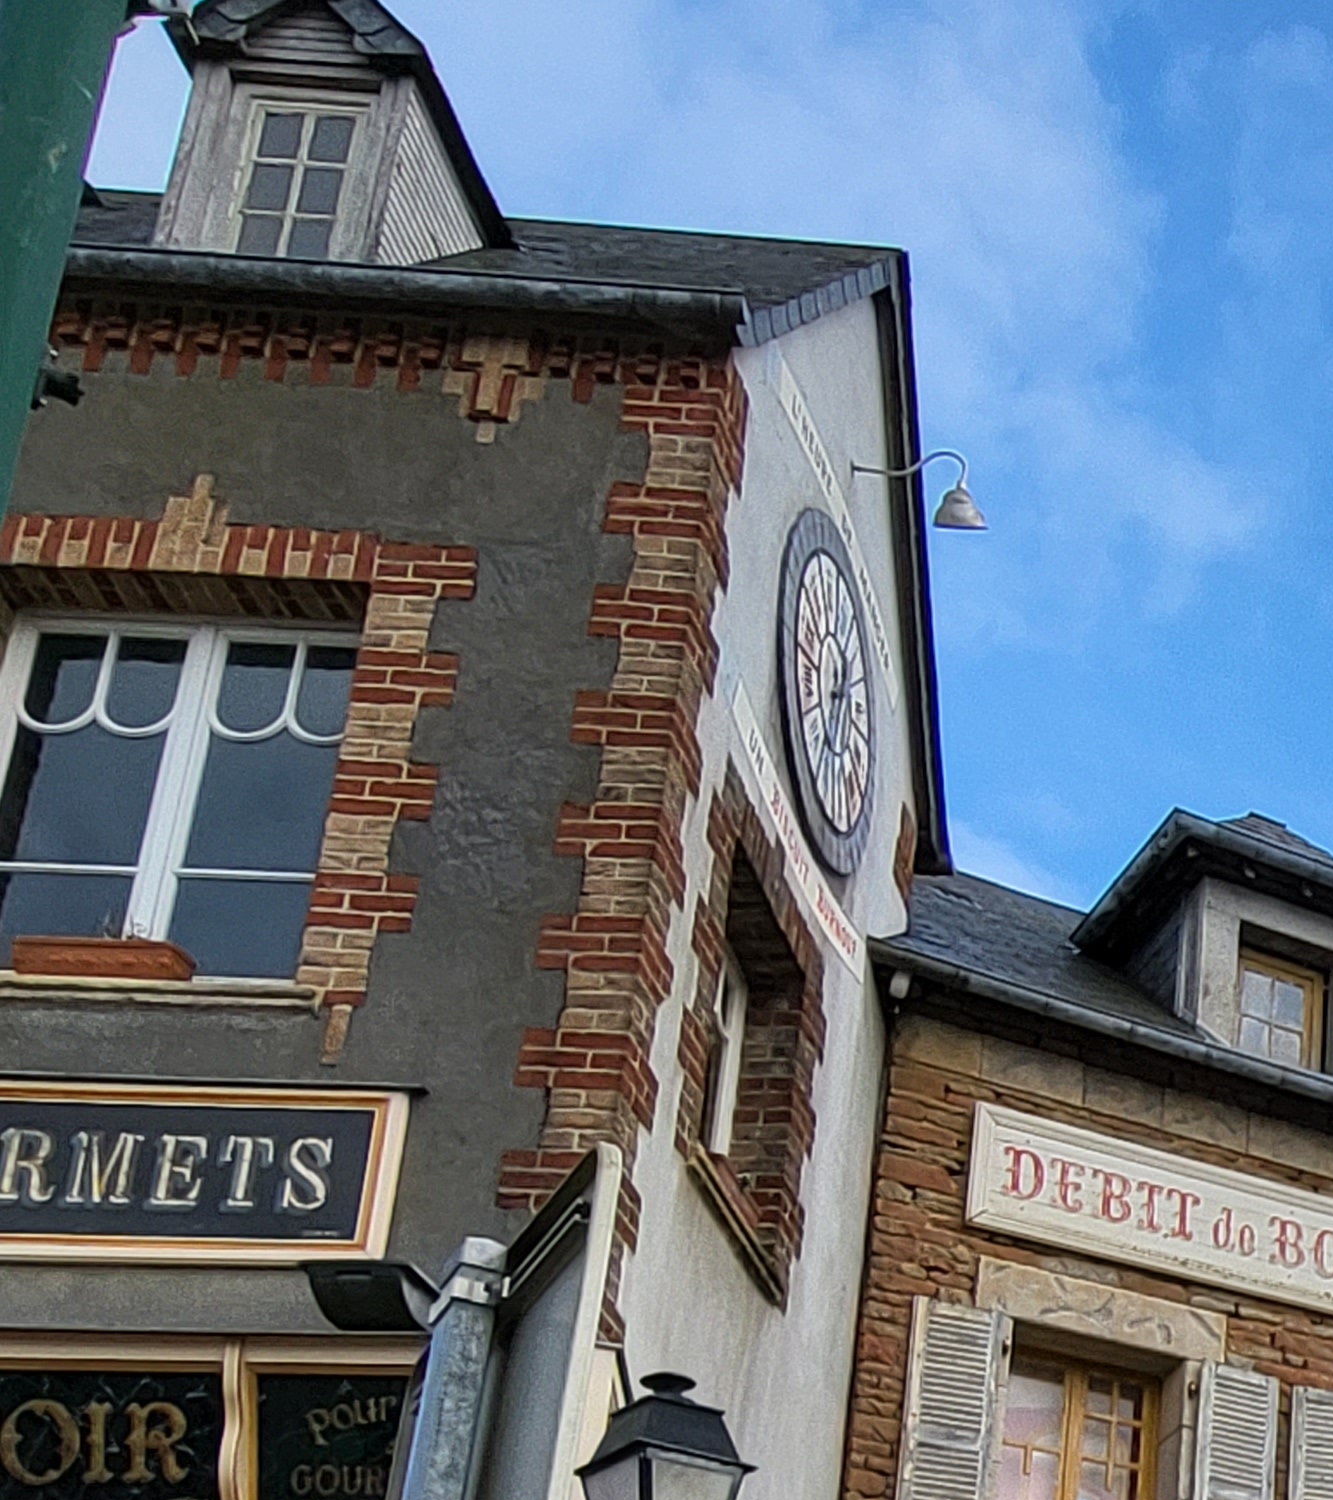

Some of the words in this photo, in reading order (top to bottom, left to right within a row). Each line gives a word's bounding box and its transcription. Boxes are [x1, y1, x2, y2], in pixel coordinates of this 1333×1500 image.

[0, 1127, 334, 1213] RMETS
[1003, 1146, 1201, 1242] DEBIT
[0, 1399, 190, 1486] OIR
